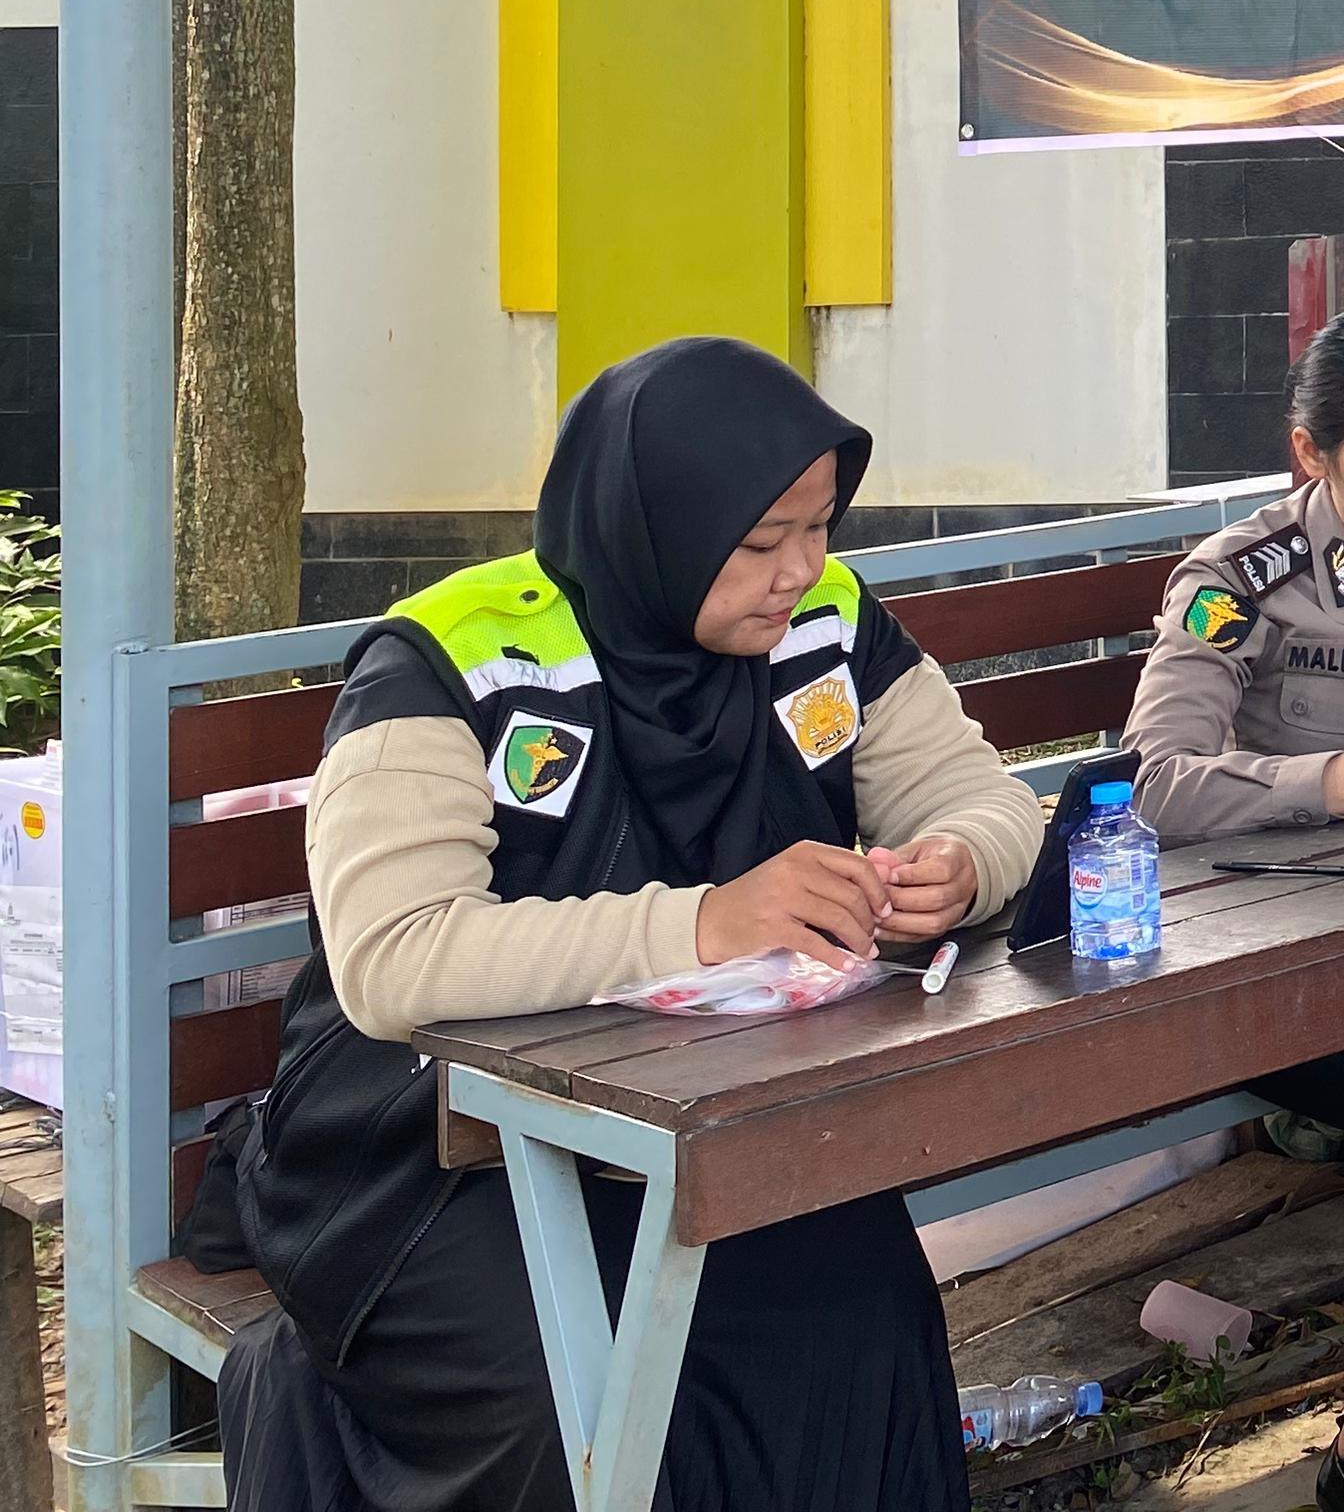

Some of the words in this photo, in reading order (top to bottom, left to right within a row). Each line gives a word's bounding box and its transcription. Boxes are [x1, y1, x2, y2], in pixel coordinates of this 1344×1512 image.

[1239, 556, 1266, 593] POLISI
[815, 726, 847, 748] POLISI
[1074, 870, 1102, 890] Alpine
